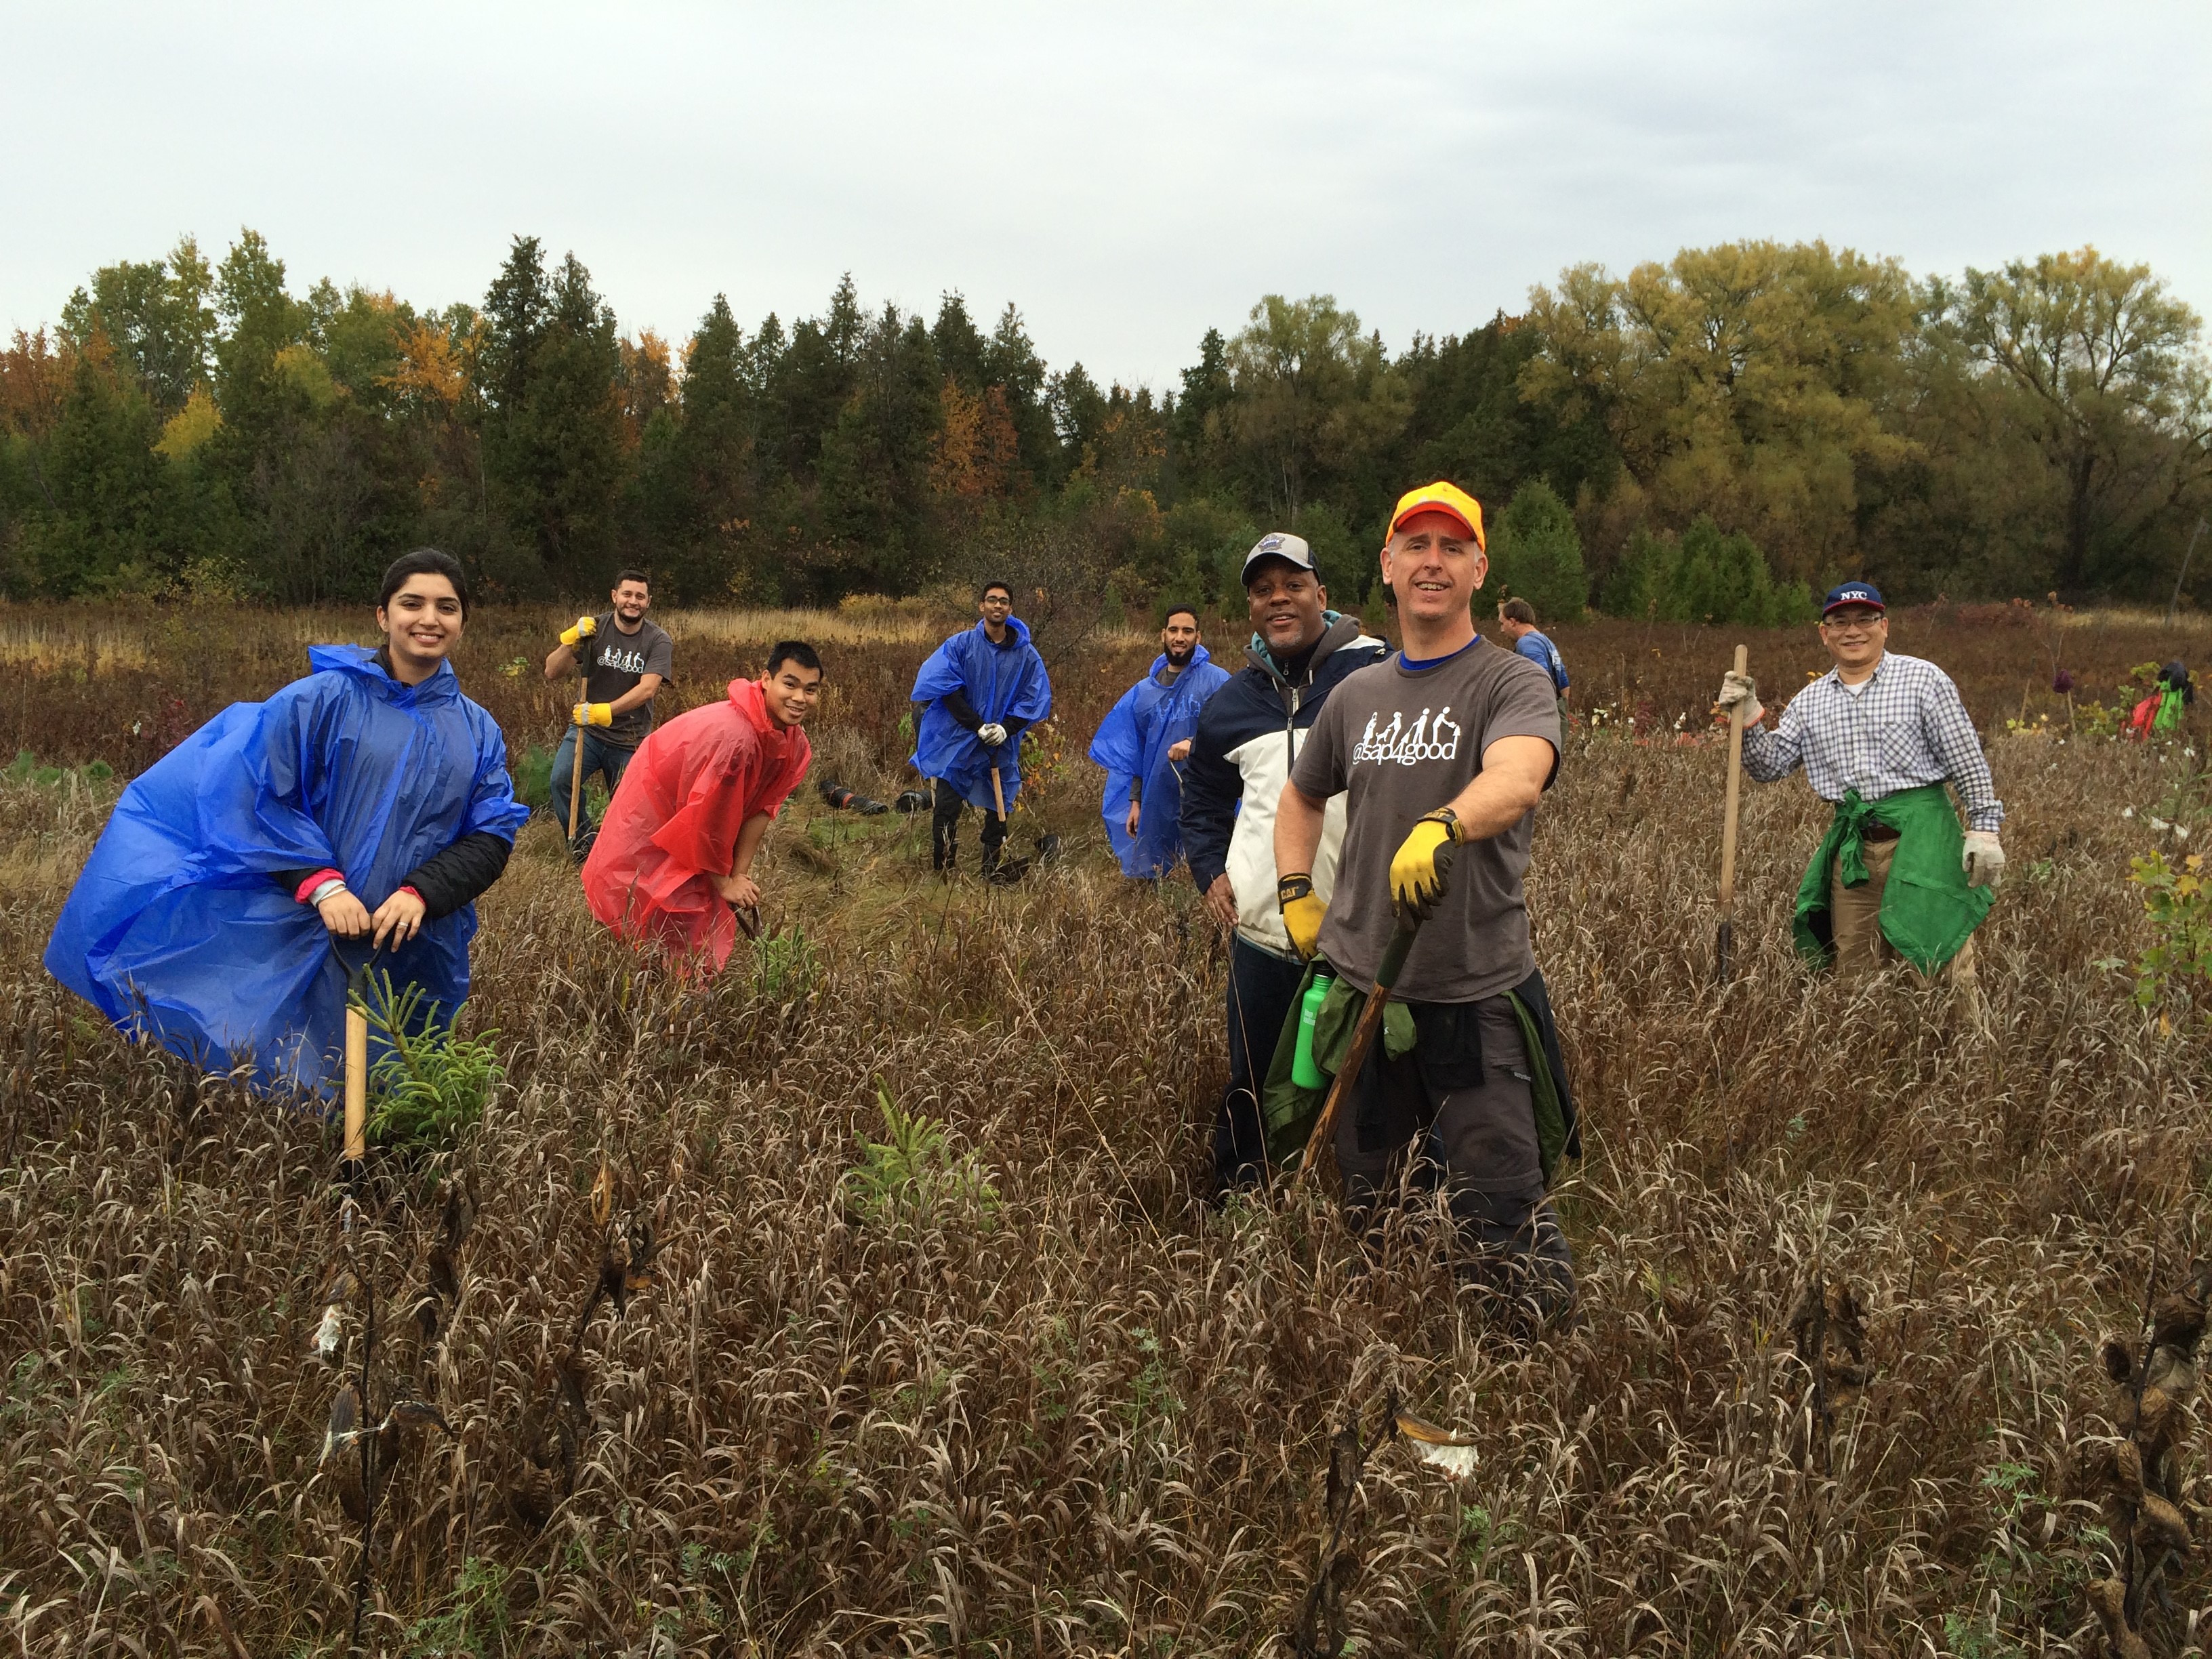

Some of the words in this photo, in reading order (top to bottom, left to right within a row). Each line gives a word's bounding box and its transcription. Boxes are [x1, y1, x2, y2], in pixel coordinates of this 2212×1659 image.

[1841, 590, 1867, 600] NYC
[597, 656, 643, 673] @sap4good
[1353, 742, 1456, 765] @sap4good
[1281, 886, 1296, 900] CAT
